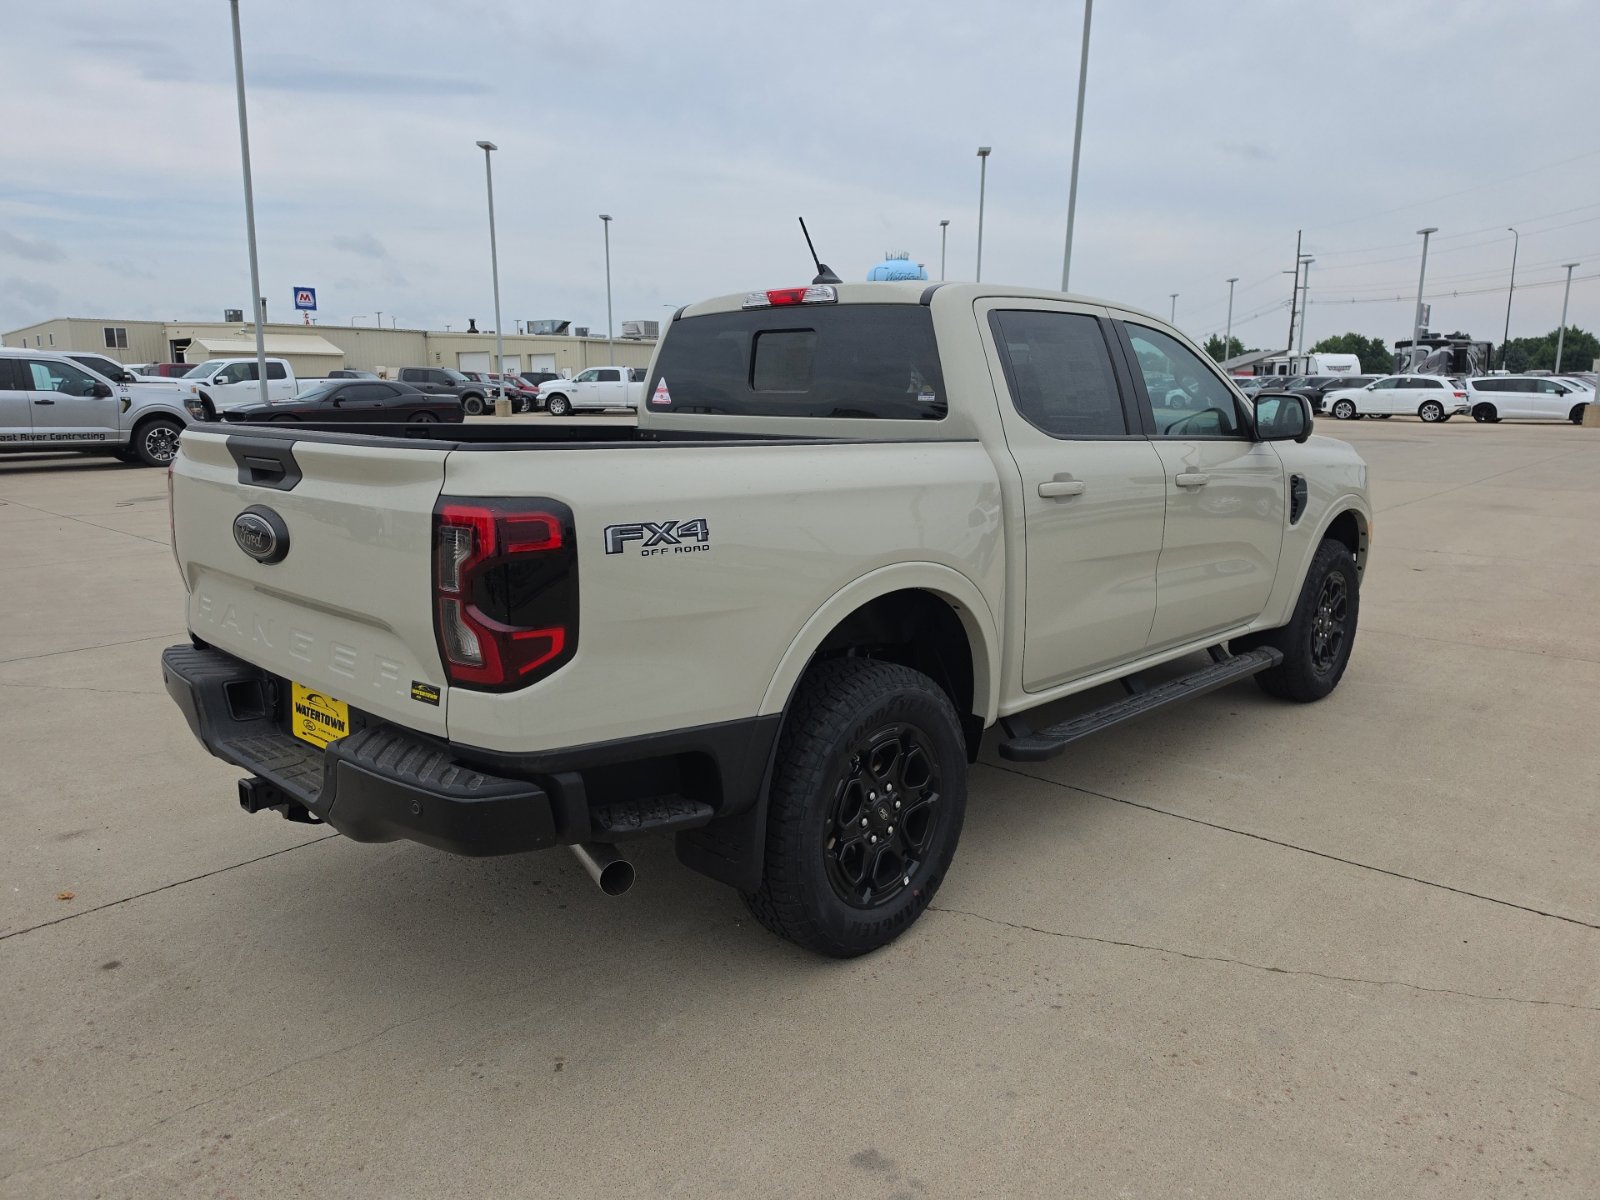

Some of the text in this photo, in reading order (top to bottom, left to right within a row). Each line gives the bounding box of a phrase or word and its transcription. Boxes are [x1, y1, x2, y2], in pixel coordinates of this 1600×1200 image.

[20, 433, 47, 441] River
[239, 525, 264, 548] Ford
[603, 518, 709, 555] FX4
[641, 544, 710, 557] OFF ROAD
[198, 592, 405, 694] RANGER
[295, 702, 345, 733] WATERTOWN
